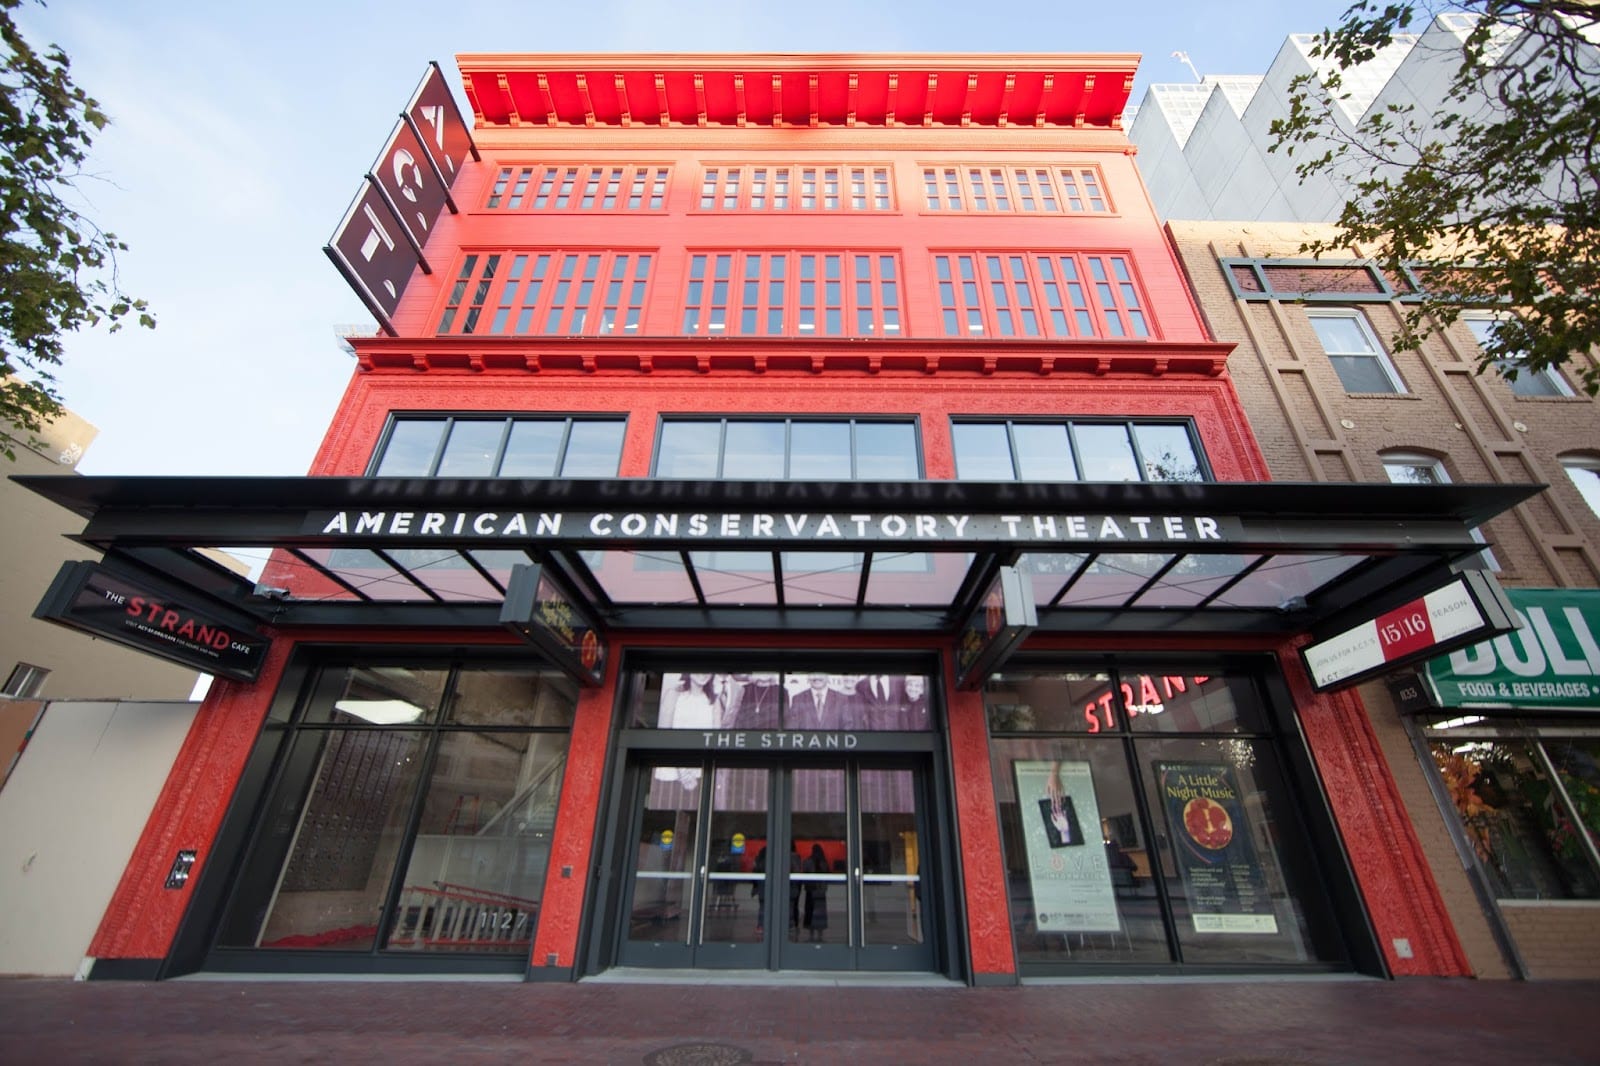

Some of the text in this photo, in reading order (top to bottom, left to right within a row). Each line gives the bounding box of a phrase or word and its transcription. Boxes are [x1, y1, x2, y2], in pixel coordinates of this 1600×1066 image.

[323, 511, 1221, 540] AMERICAN CONSERVATORY THEATER
[1431, 599, 1468, 618] SEASON
[105, 590, 251, 655] THE STRAND CAFE
[1457, 682, 1591, 698] FOOD & BEVERAGES
[1085, 675, 1209, 733] STRAN
[703, 733, 858, 749] THE STRAND
[1178, 774, 1218, 787] A Little
[1166, 786, 1235, 801] Night Music
[481, 911, 528, 929] 1127
